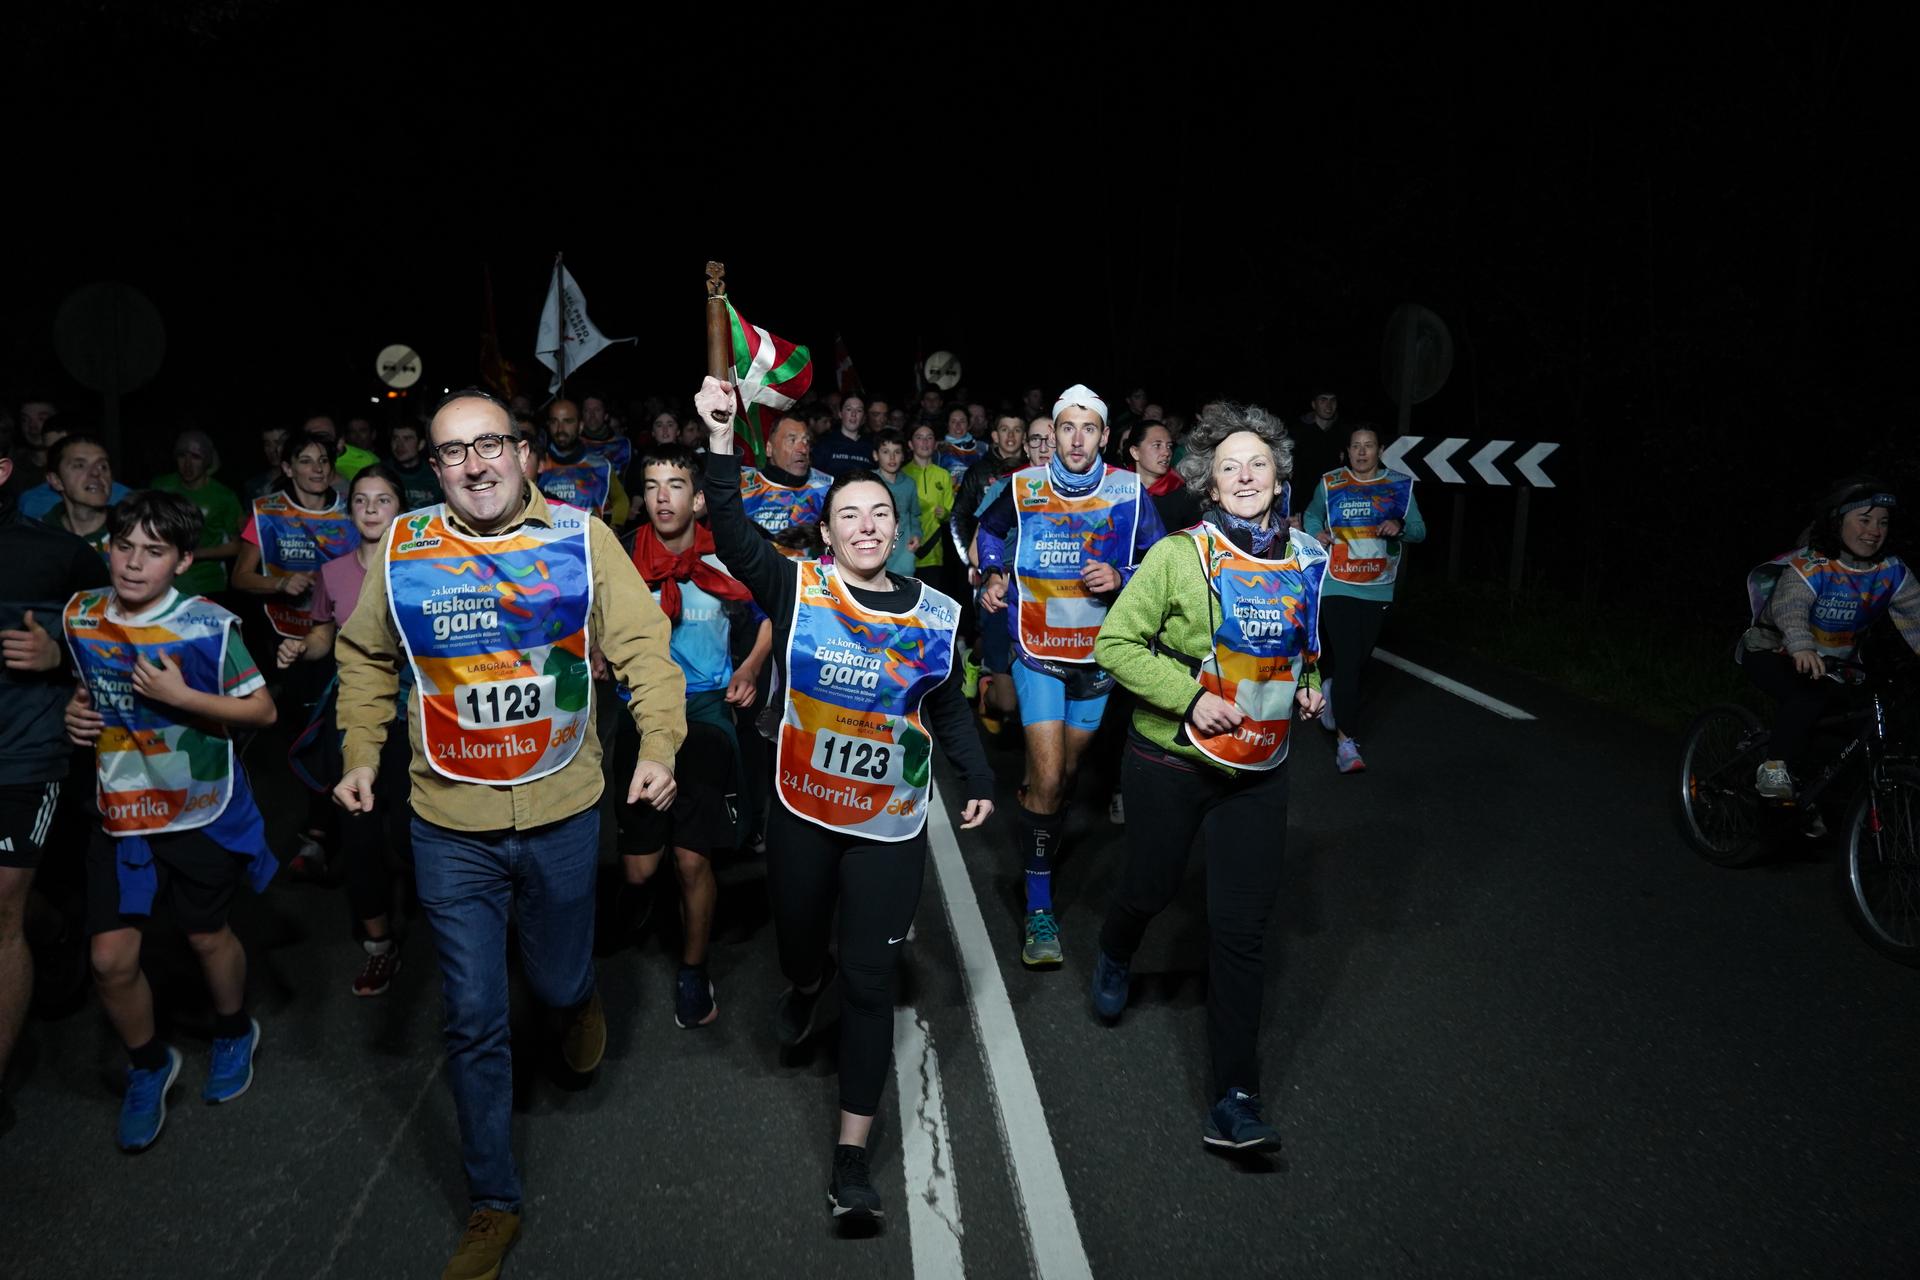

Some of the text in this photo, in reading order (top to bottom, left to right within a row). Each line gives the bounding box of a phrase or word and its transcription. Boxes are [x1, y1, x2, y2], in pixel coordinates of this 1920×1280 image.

[1115, 484, 1136, 494] eitb
[1342, 508, 1371, 519] gara
[1035, 540, 1080, 551] Euskara
[1040, 551, 1080, 567] gara
[431, 584, 476, 597] 24.korrika
[422, 597, 495, 616] Euskara
[931, 605, 954, 623] eitb
[1815, 607, 1857, 621] gara
[433, 611, 498, 640] gara
[1026, 632, 1094, 647] 24.korrika
[814, 646, 881, 671] Euskara
[468, 663, 513, 673] LABORAL
[818, 663, 880, 690] gara
[467, 683, 541, 724] 1123
[836, 715, 875, 728] LABORAL
[1233, 726, 1276, 747] orrika
[438, 735, 538, 760] 24.korrika
[824, 736, 890, 780] 1123
[782, 770, 873, 811] 24.korrika
[107, 796, 170, 821] orrika
